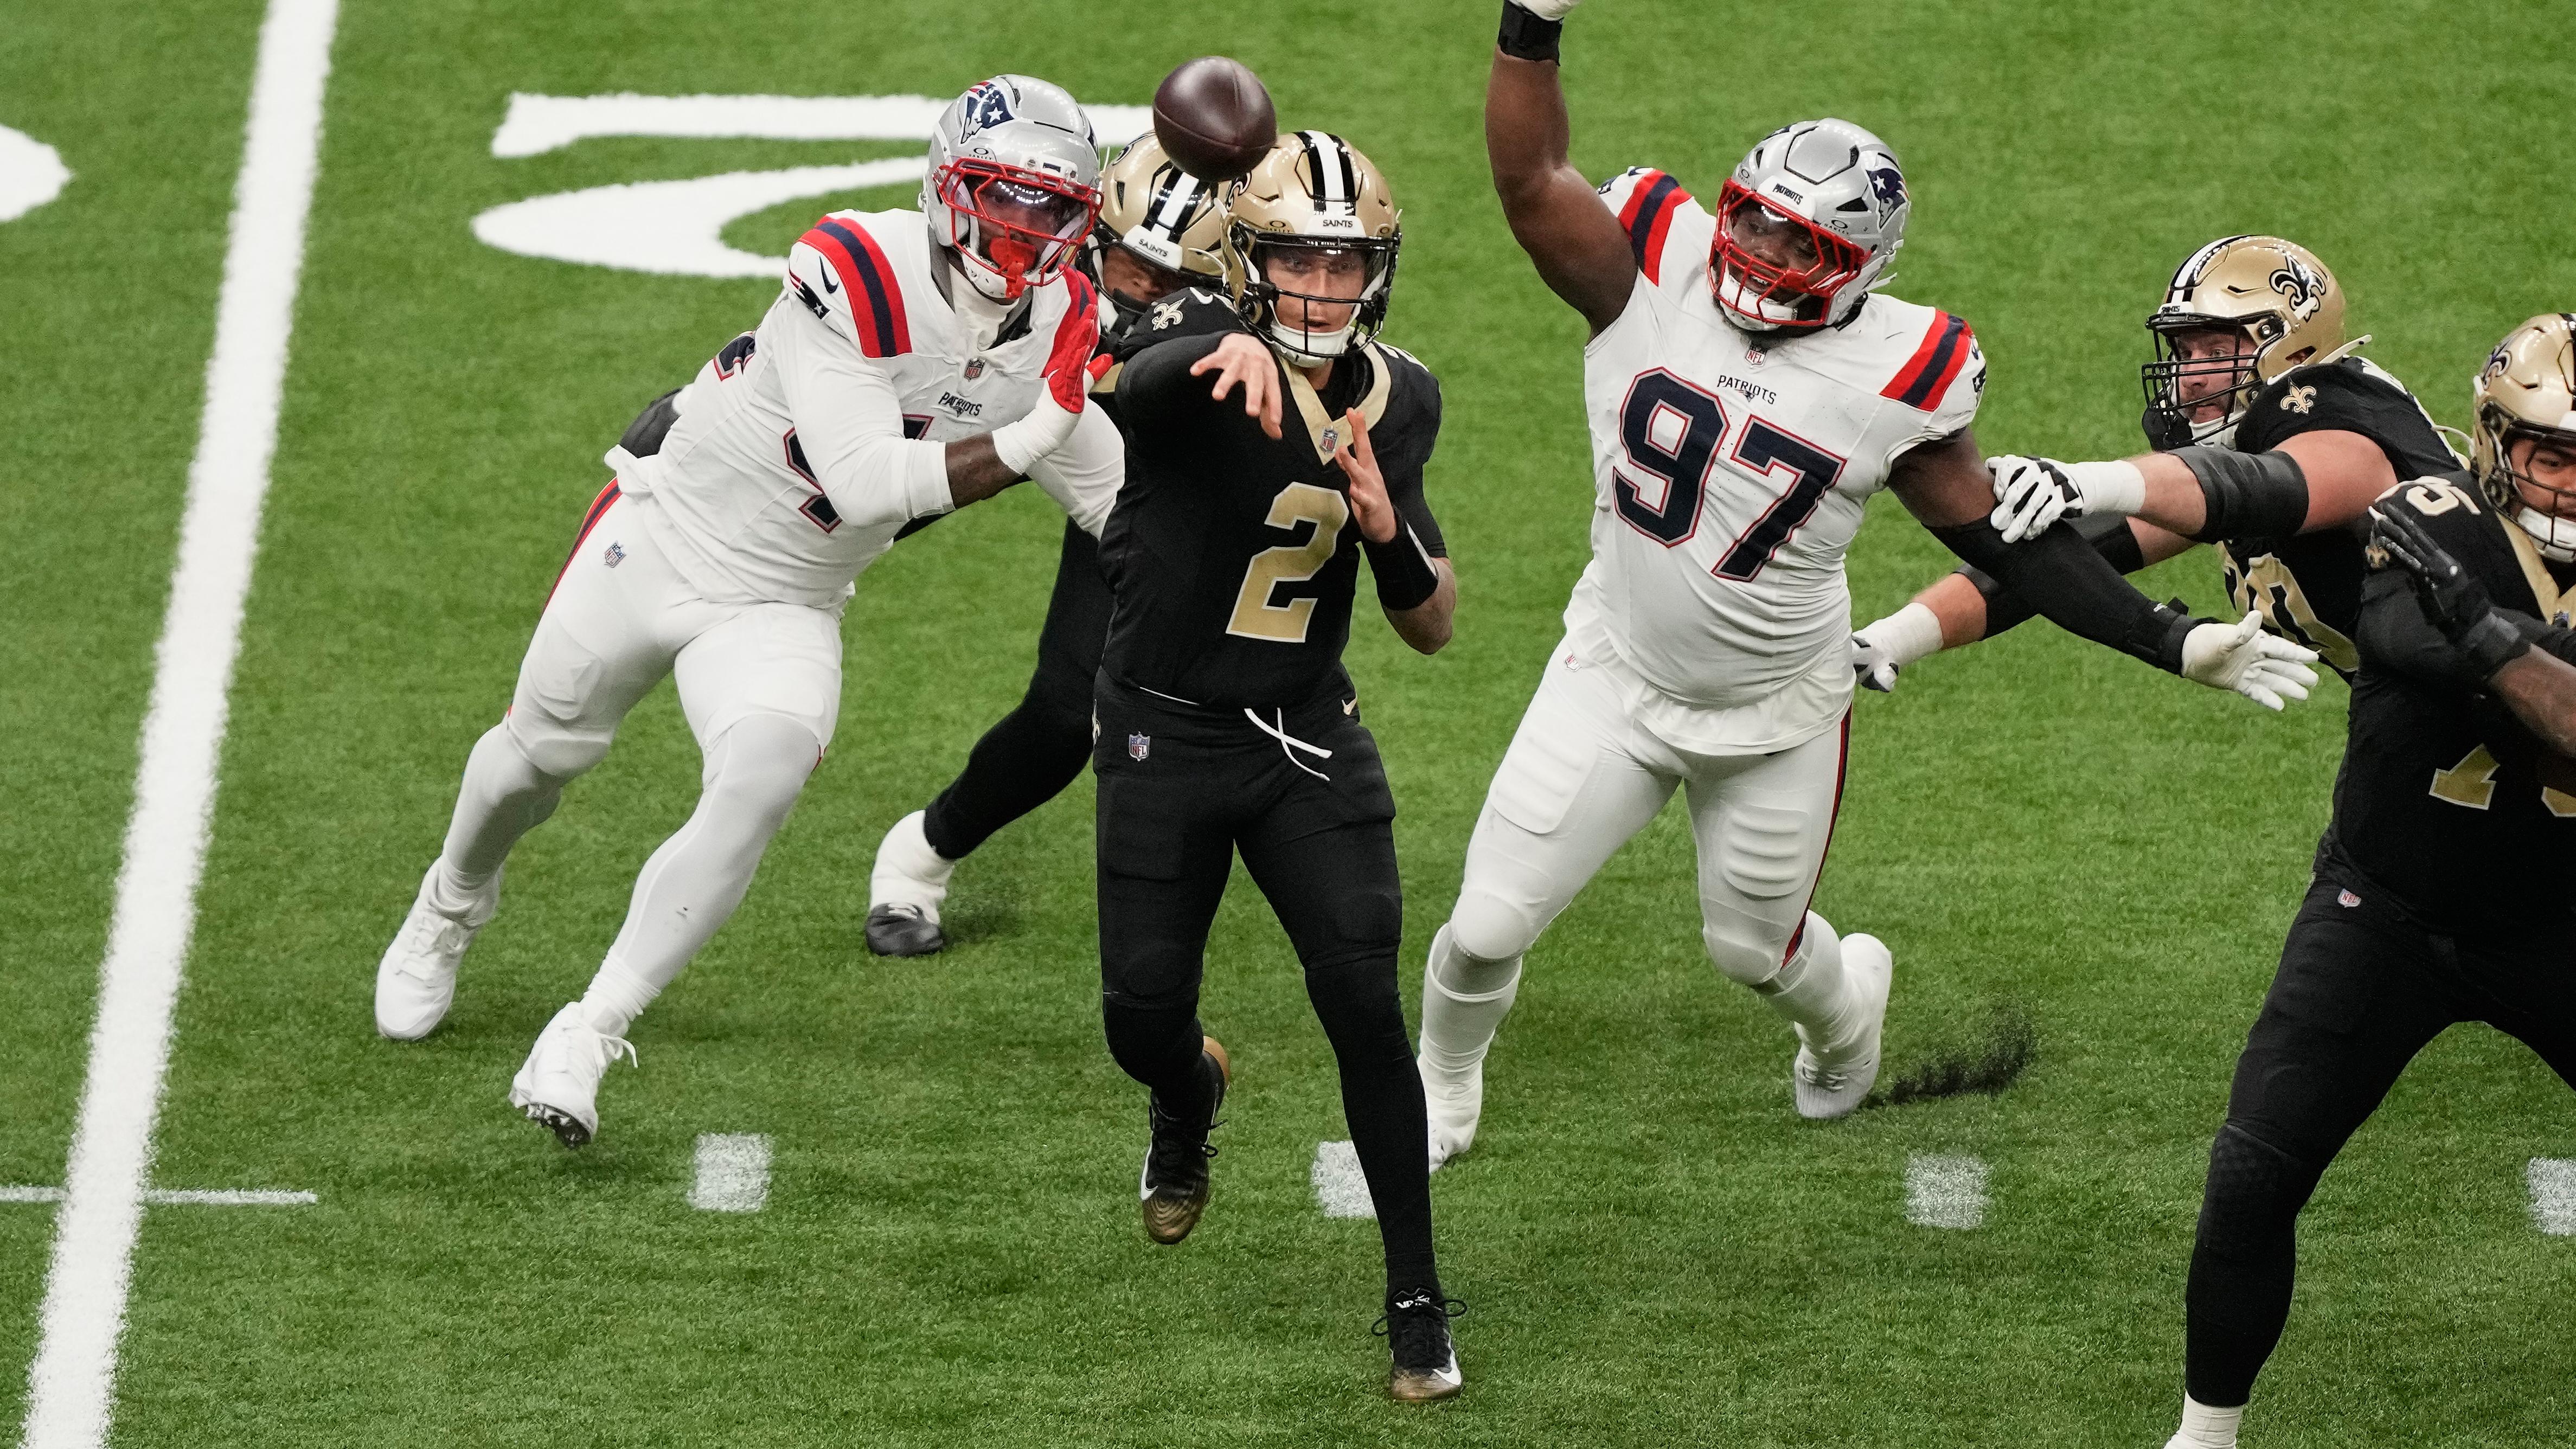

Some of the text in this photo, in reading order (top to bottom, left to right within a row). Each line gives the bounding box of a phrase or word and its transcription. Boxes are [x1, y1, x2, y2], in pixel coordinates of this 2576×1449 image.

[1772, 183, 1803, 205] PATRIOTS
[1323, 220, 1353, 228] SAINTS
[1139, 239, 1168, 257] SAINTS
[1747, 350, 1763, 363] NFL
[966, 368, 979, 377] NFL
[1717, 375, 1777, 405] PATRIOTS
[938, 391, 982, 416] PATRIOTS
[1613, 367, 1847, 582] 97
[1226, 482, 1349, 643] 2
[1132, 746, 1146, 755] NFL
